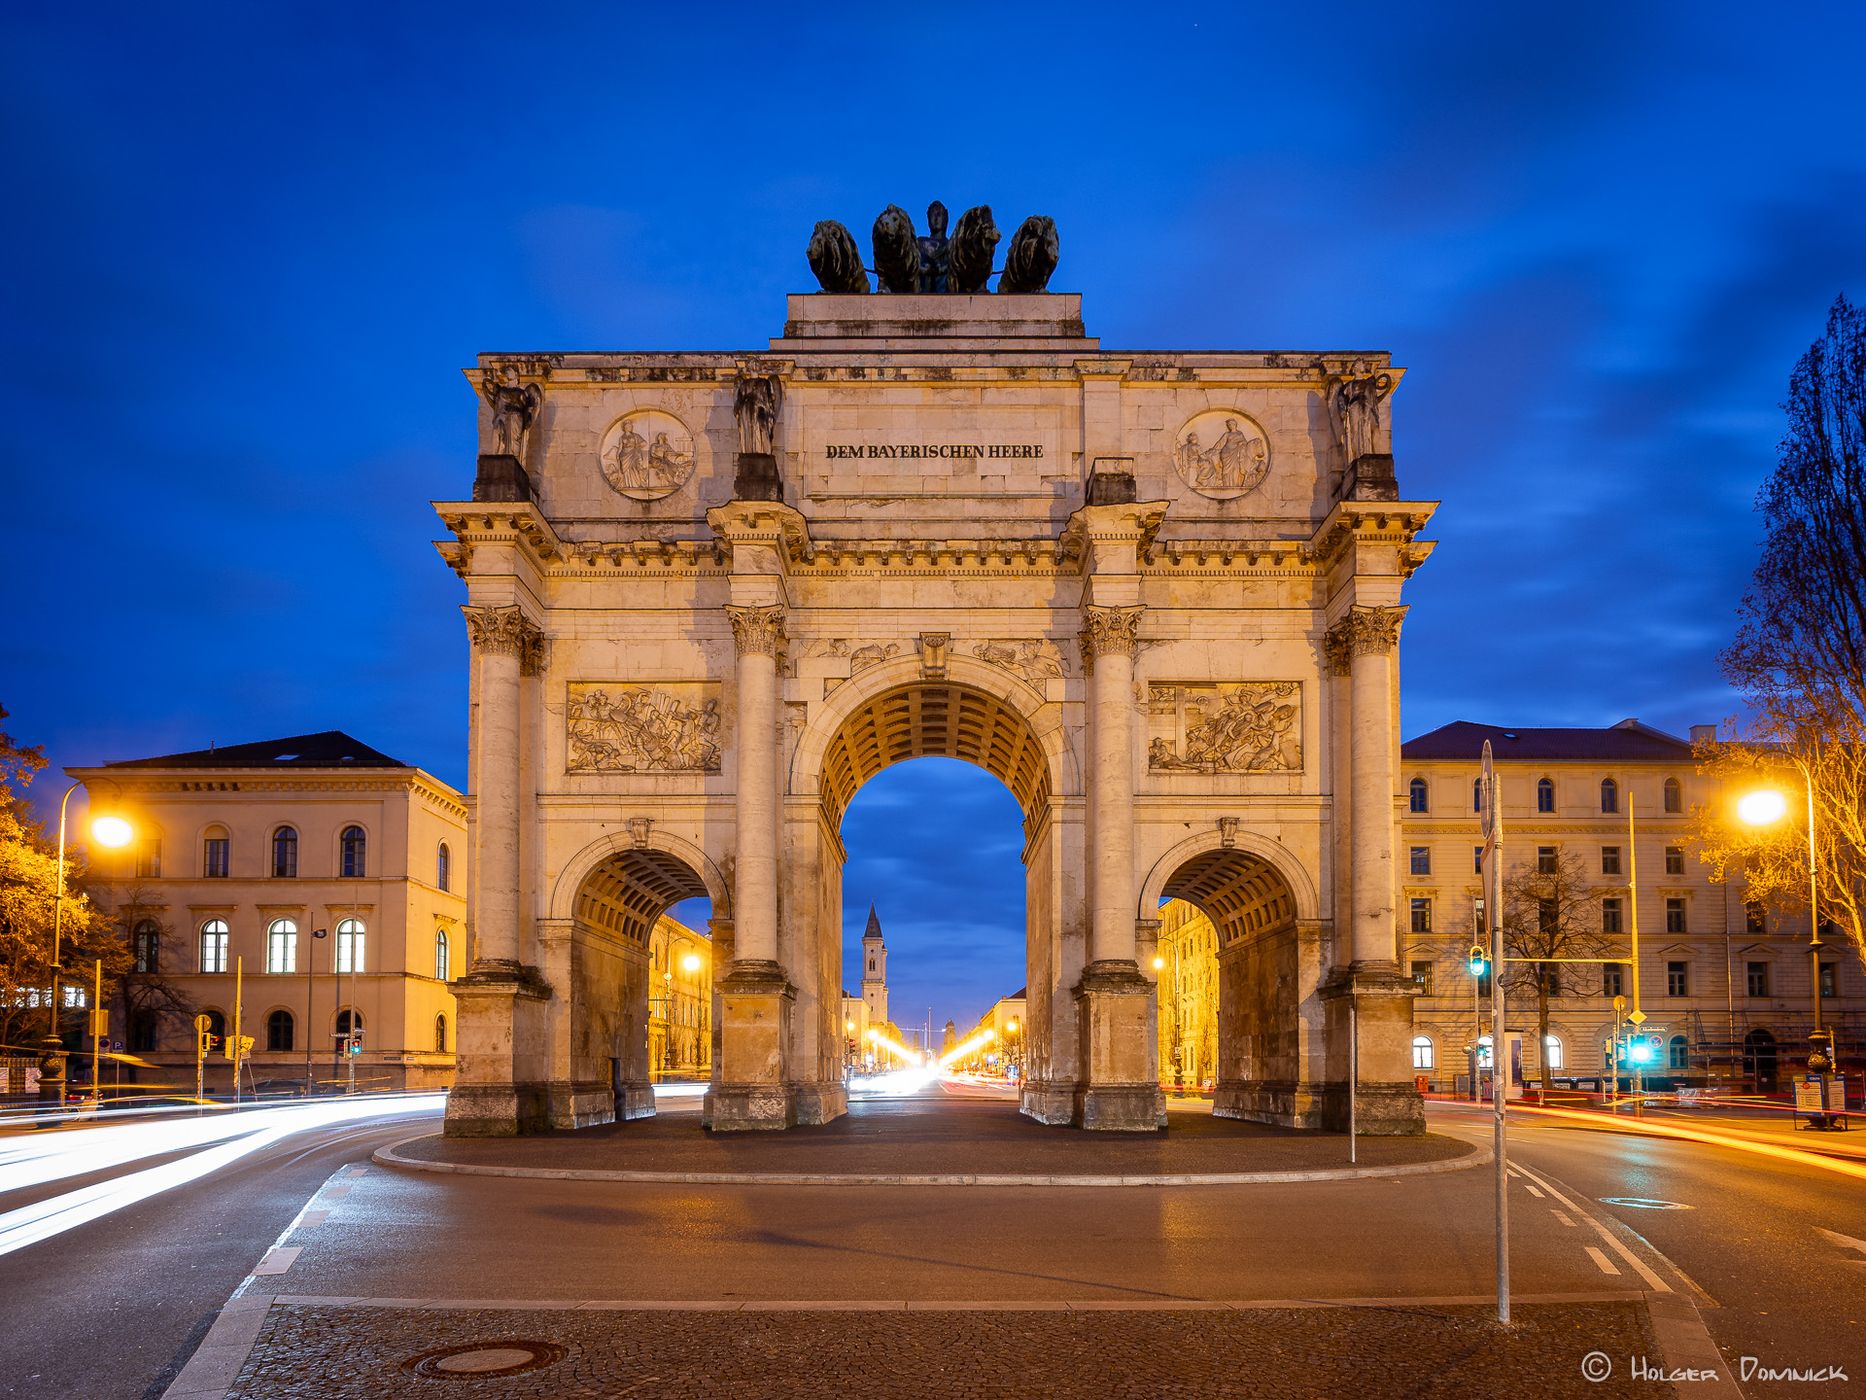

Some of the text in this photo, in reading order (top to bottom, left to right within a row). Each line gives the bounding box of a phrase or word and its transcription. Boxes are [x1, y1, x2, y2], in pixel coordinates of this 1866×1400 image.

[826, 445, 1043, 458] DEM BAYERISCHEN HEERE
